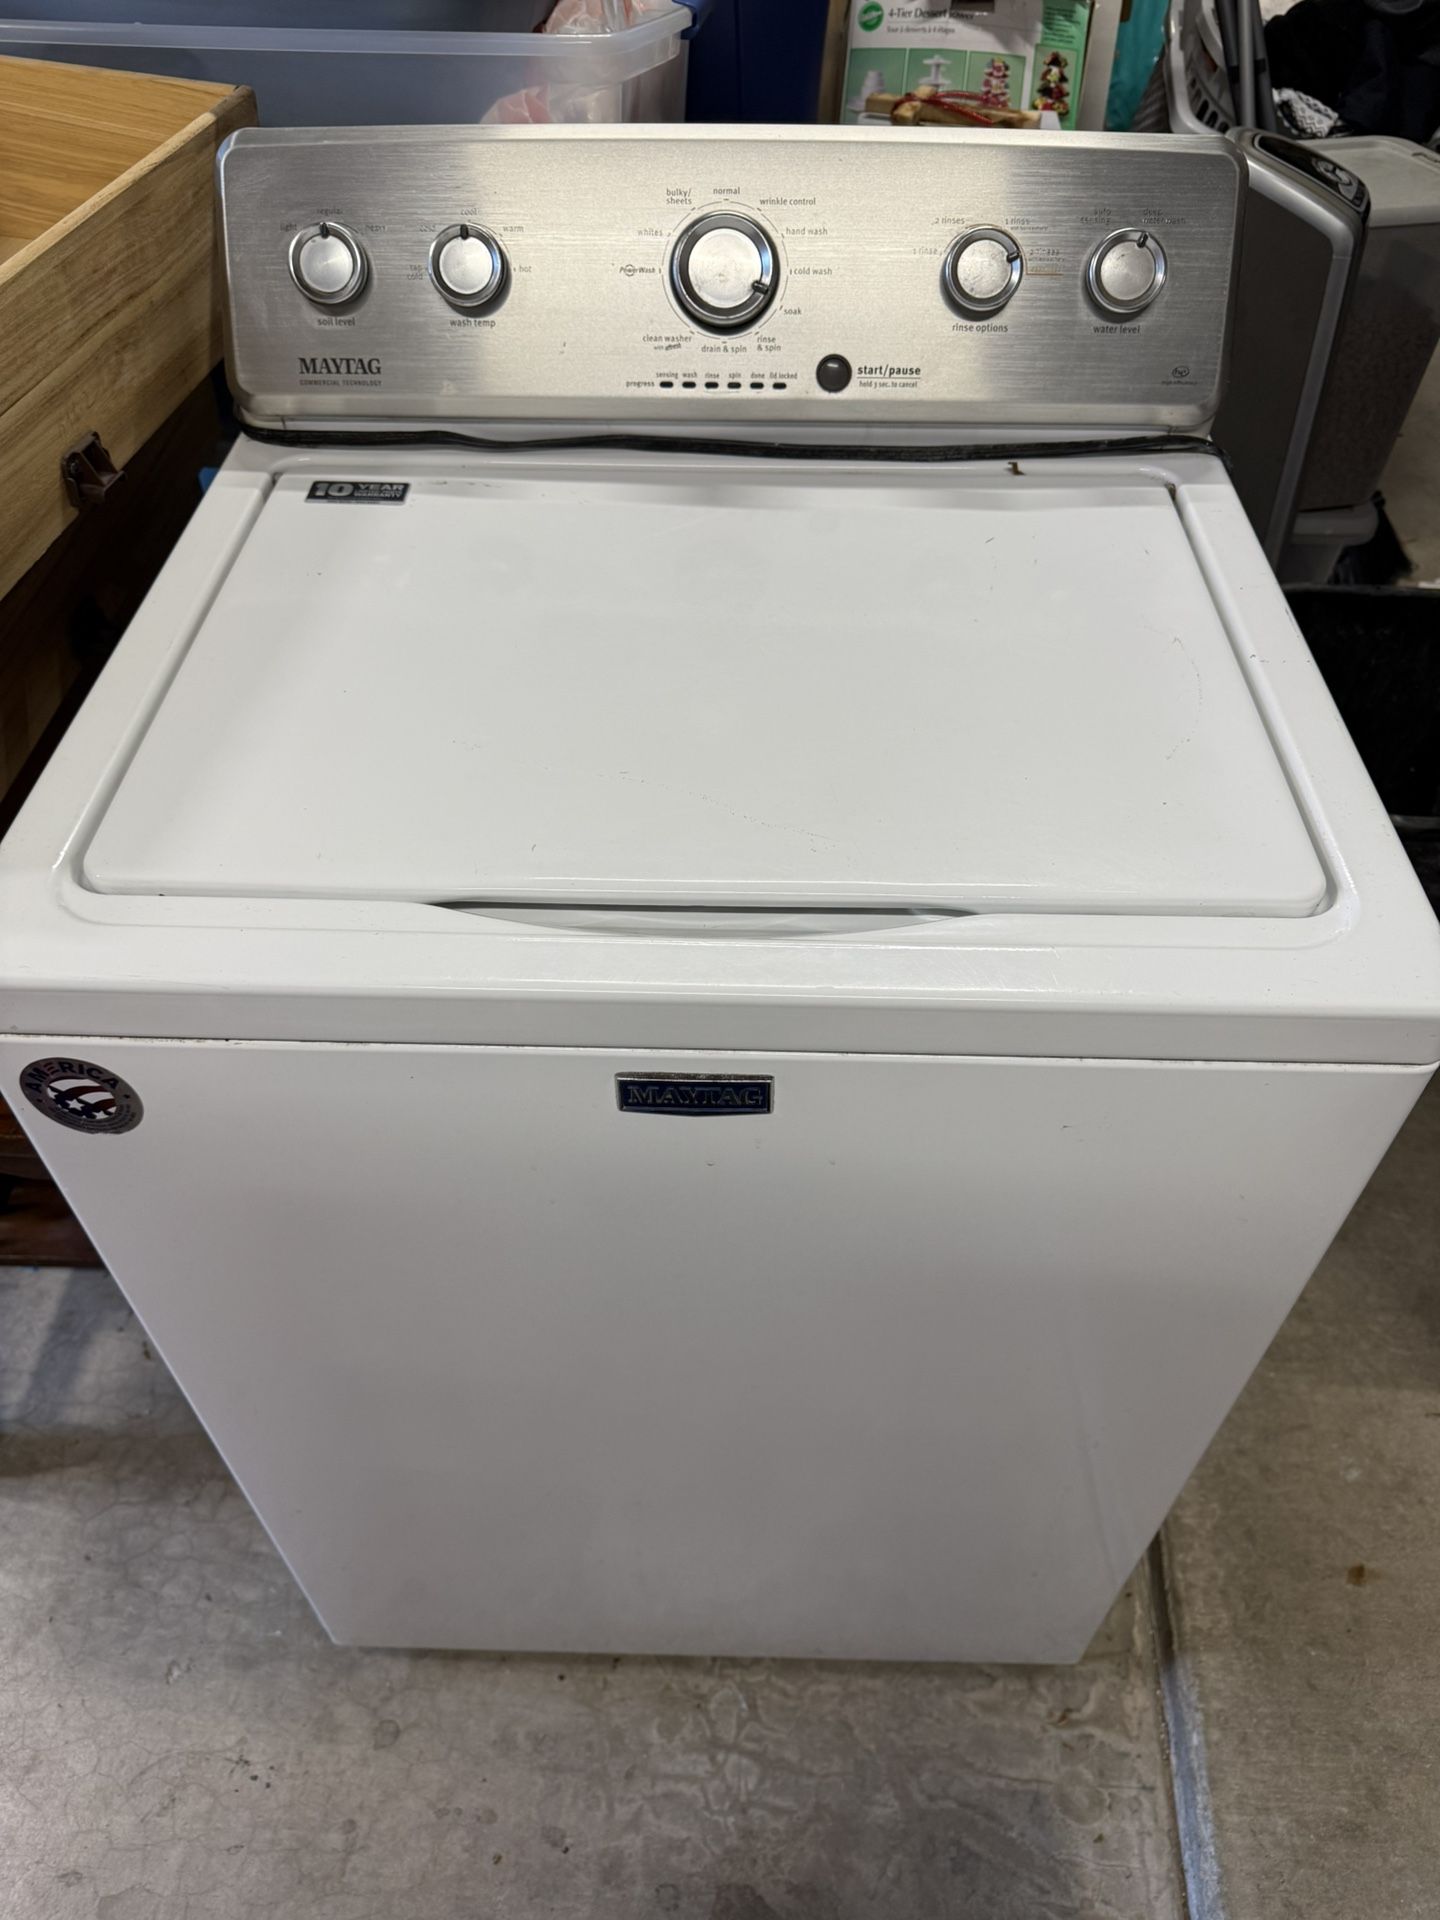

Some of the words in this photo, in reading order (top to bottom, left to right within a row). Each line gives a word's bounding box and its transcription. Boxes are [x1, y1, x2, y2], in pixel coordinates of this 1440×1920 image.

[666, 188, 692, 197] bulky/
[713, 187, 741, 195] normal
[666, 197, 692, 205] sheets
[760, 197, 788, 206] wrinkle
[789, 197, 816, 206] control
[941, 216, 966, 225] rinses
[637, 228, 663, 237] whites
[786, 227, 806, 236] hand
[807, 227, 828, 236] wash
[519, 265, 532, 273] hot
[794, 267, 811, 276] cold
[812, 267, 833, 276] wash
[783, 308, 802, 316] soak
[318, 317, 333, 327] soil
[335, 317, 356, 327] level
[450, 318, 472, 328] wash
[474, 319, 497, 329] temp
[952, 323, 974, 333] rinse
[976, 323, 1008, 334] options
[1093, 325, 1118, 334] water
[1120, 325, 1141, 334] level
[642, 334, 663, 342] clean
[664, 334, 692, 343] washer
[757, 335, 776, 343] rinse
[701, 345, 721, 353] drain
[723, 345, 730, 354] &
[731, 345, 747, 355] spin
[765, 344, 781, 352] spin
[298, 357, 382, 375] MAYTAG
[857, 363, 921, 377] start/pause
[656, 371, 678, 380] sensing
[682, 371, 698, 379] wash
[728, 372, 741, 380] spin
[750, 372, 765, 380] done
[778, 372, 798, 380] locked
[626, 380, 655, 388] progress
[859, 380, 873, 388] hold
[899, 381, 918, 389] cancel
[314, 483, 354, 496] 10
[25, 1061, 120, 1093] AMERICA
[627, 1085, 763, 1106] MAYTAG
